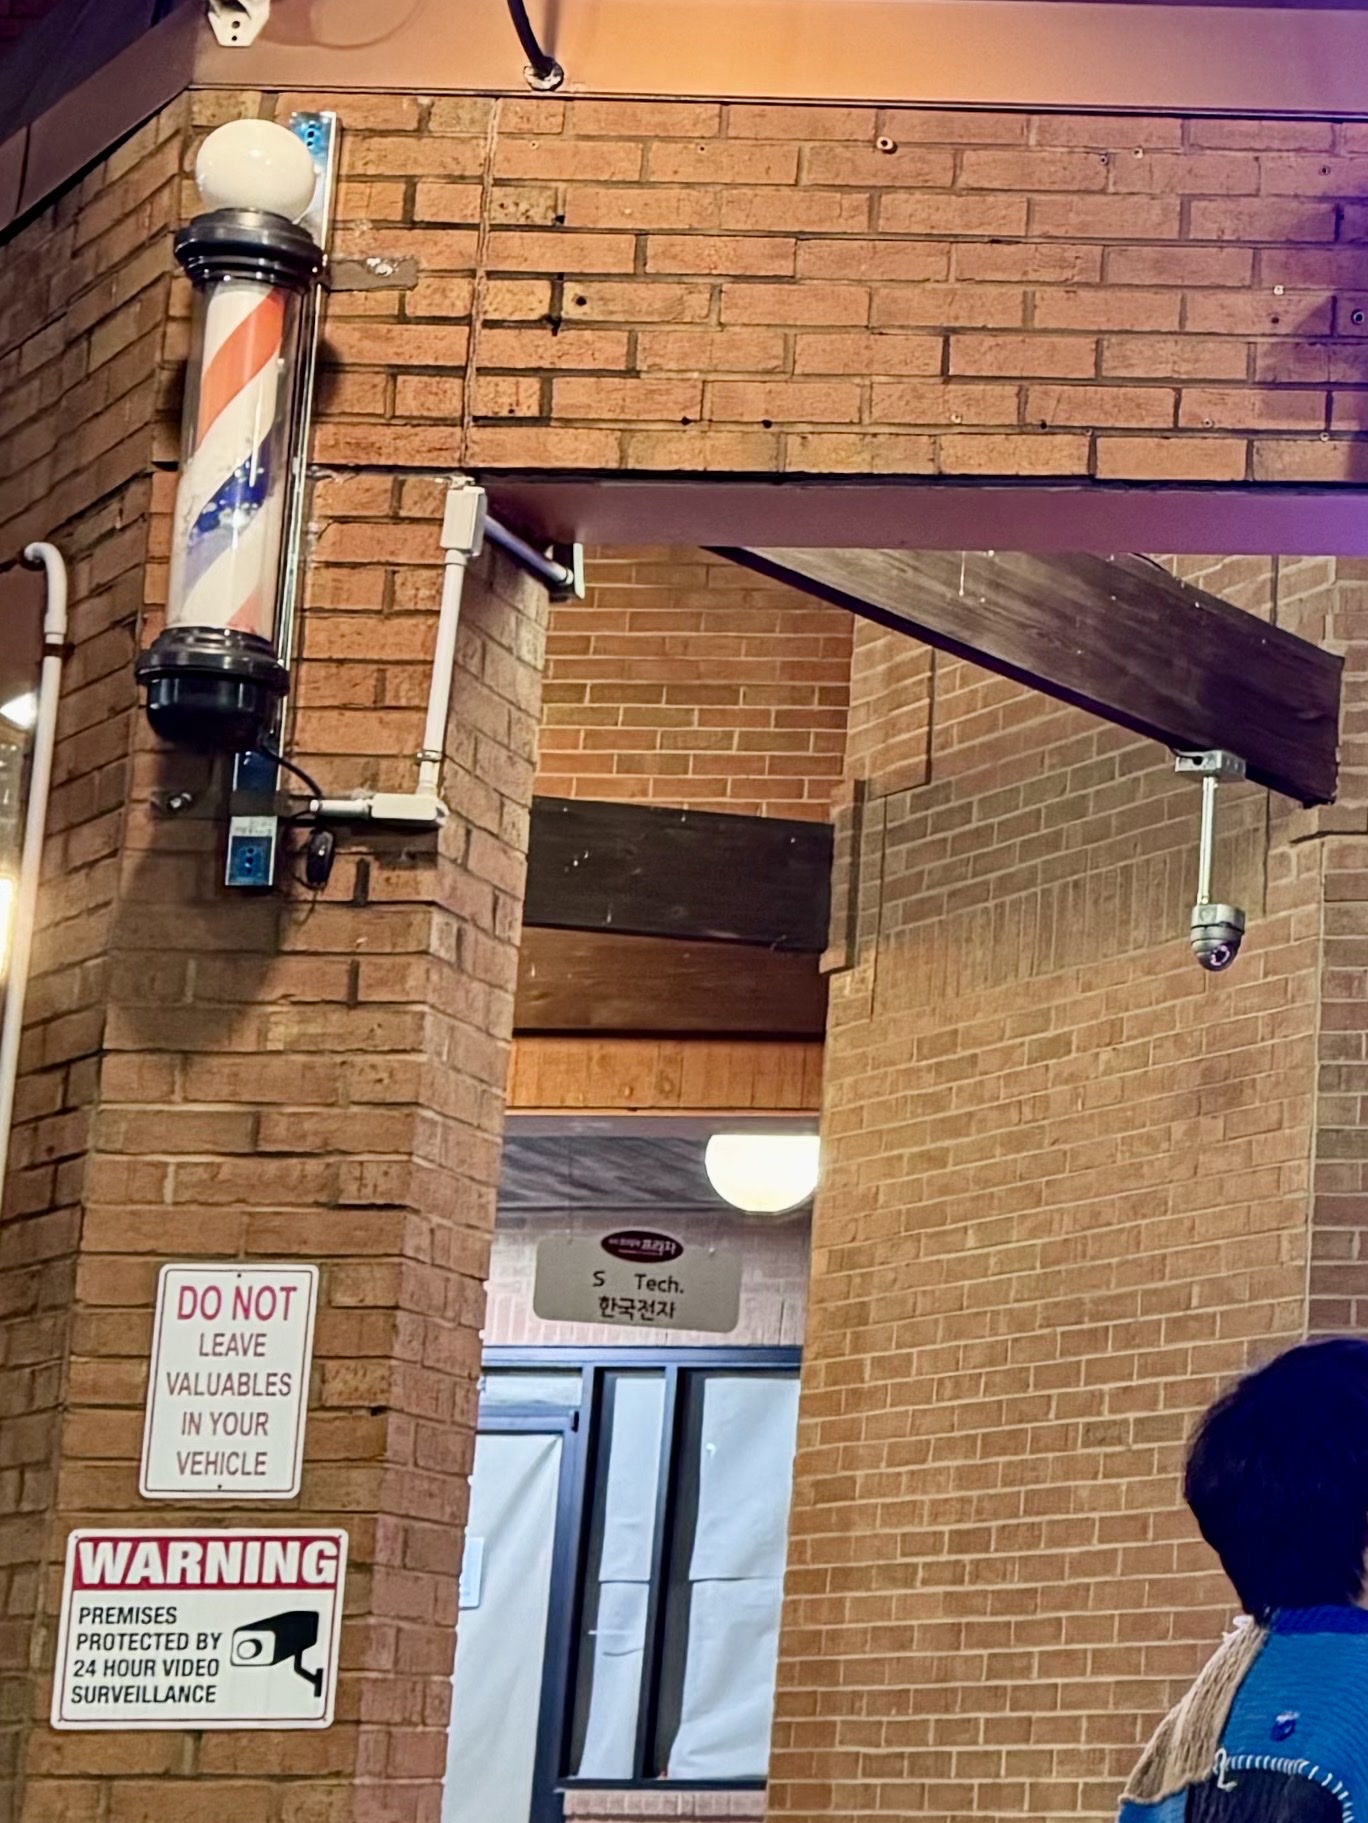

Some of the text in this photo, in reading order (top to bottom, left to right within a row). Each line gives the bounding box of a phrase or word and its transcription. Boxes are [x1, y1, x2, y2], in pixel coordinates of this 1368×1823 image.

[592, 1270, 684, 1294] S Tech.
[177, 1285, 298, 1321] DO NOT
[598, 1294, 676, 1322] 한국전자
[199, 1332, 268, 1357] LEAVE
[166, 1372, 292, 1397] VALUABLES
[181, 1411, 269, 1437] IN YOUR
[177, 1451, 268, 1477] VEHICLE
[78, 1540, 339, 1585] WARNING
[78, 1606, 178, 1625] PREMISES
[76, 1632, 223, 1651] PROTECTED BY
[73, 1659, 220, 1677] 24 HOUR VIDEO
[71, 1685, 217, 1704] SURVEILLANCE
